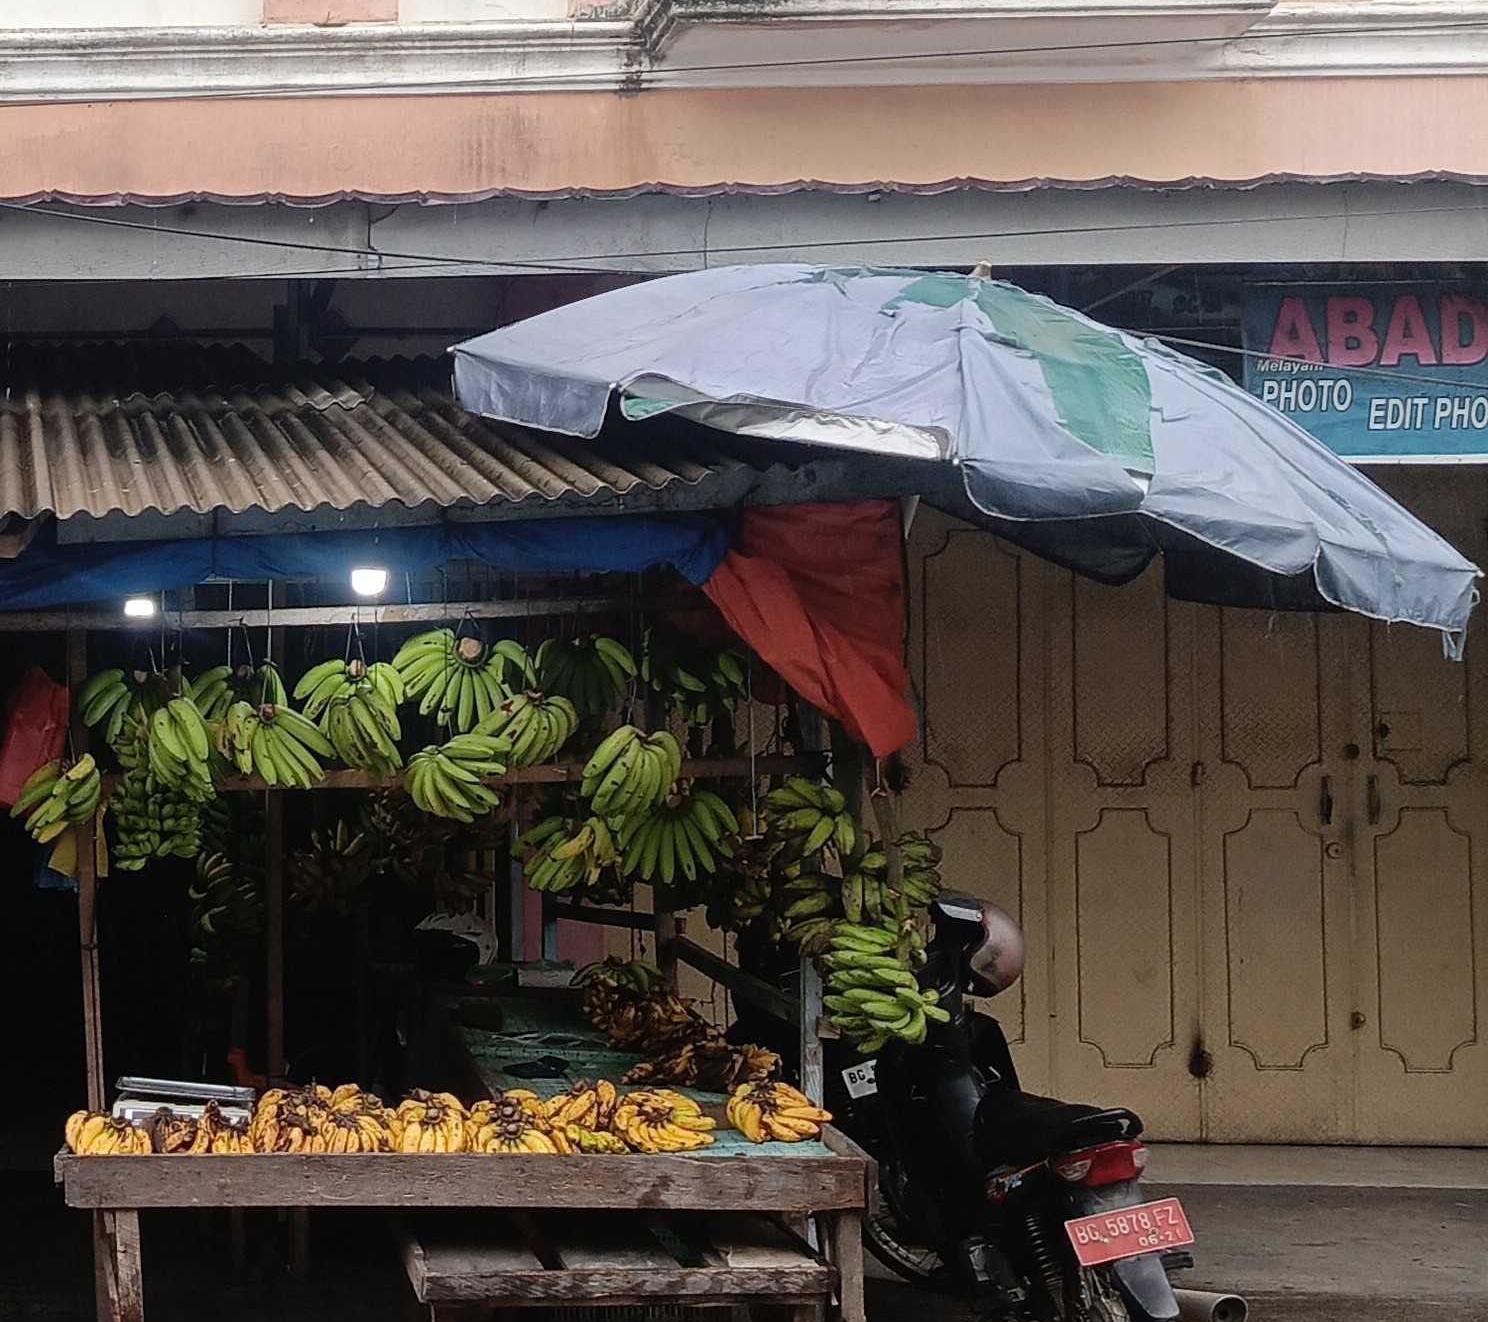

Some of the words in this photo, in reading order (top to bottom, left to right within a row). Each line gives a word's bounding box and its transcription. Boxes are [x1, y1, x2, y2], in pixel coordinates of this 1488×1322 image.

[1263, 379, 1353, 412] PHOTO
[1368, 397, 1433, 430] EDIT
[1075, 1223, 1100, 1244] BG
[1105, 1212, 1151, 1237] 5878
[1152, 1206, 1179, 1226] FZ
